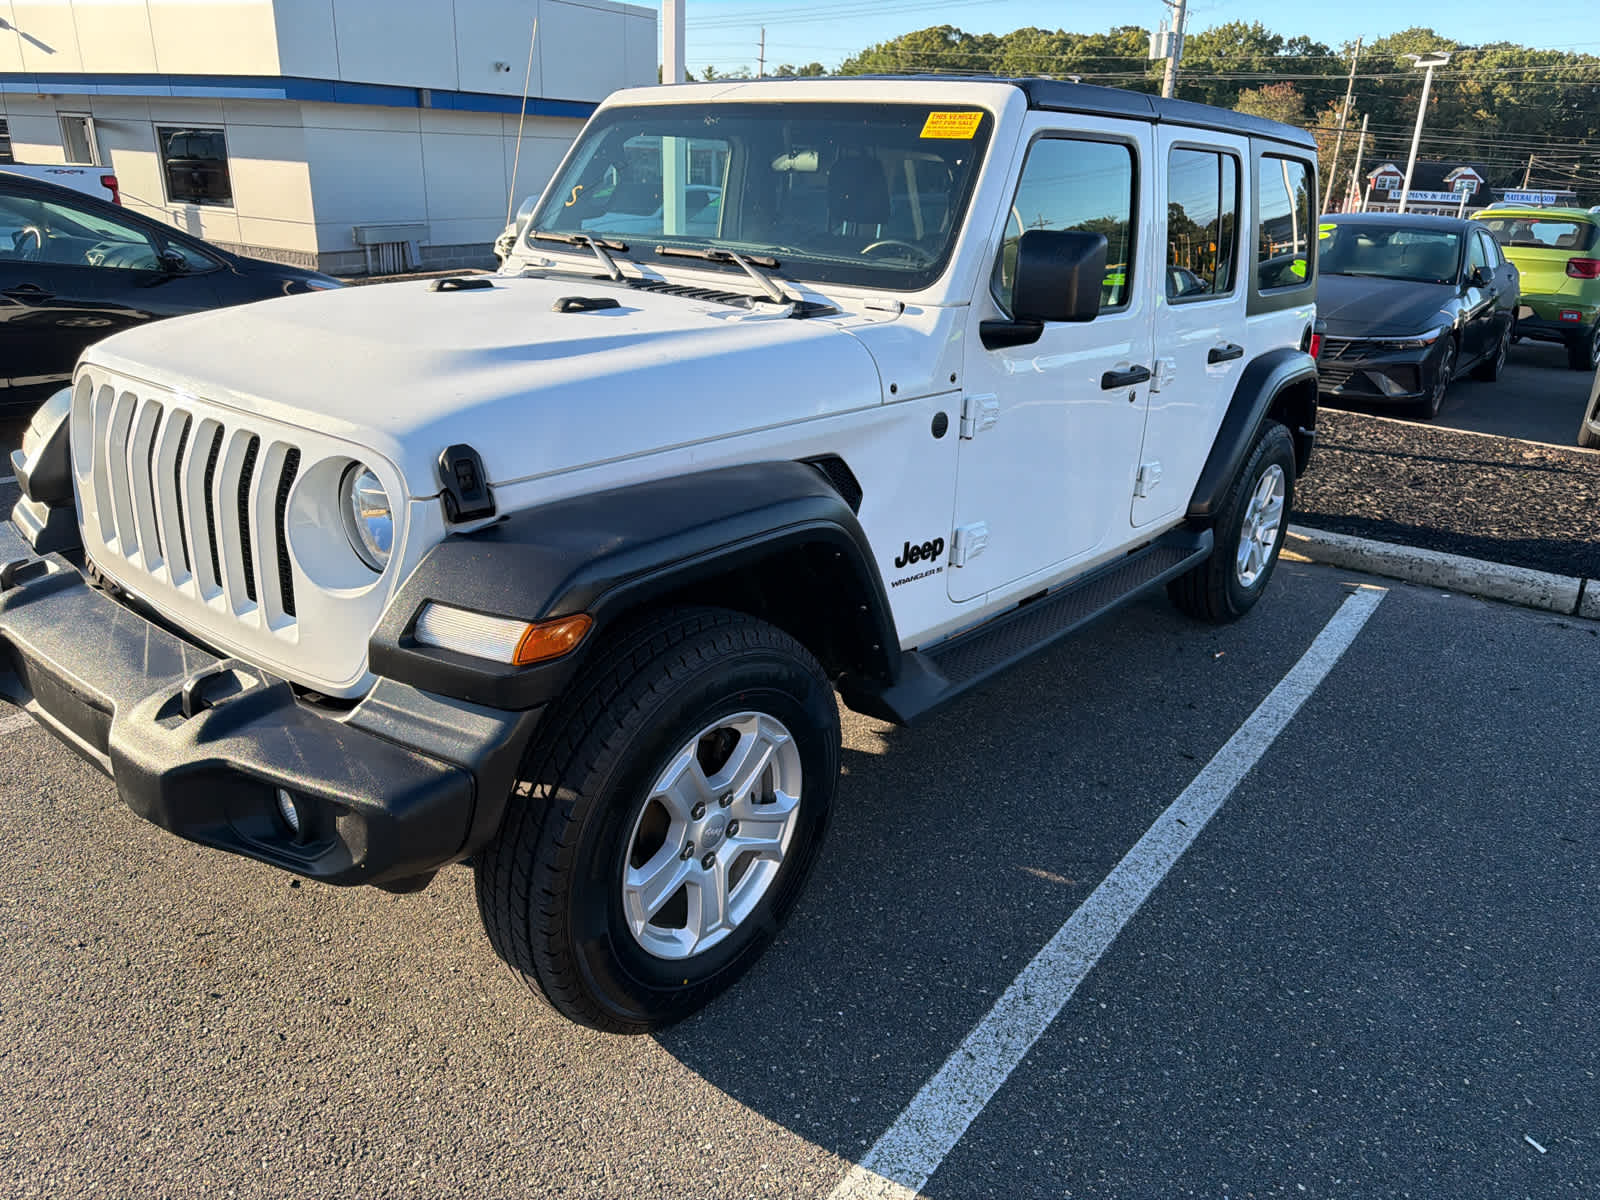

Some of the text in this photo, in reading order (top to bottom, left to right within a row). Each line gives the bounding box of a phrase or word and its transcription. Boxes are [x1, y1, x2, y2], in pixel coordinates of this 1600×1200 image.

[1392, 191, 1429, 199] VIMINS
[1440, 193, 1464, 201] HERB
[895, 537, 944, 568] Jeep
[891, 569, 936, 588] WRANGLER
